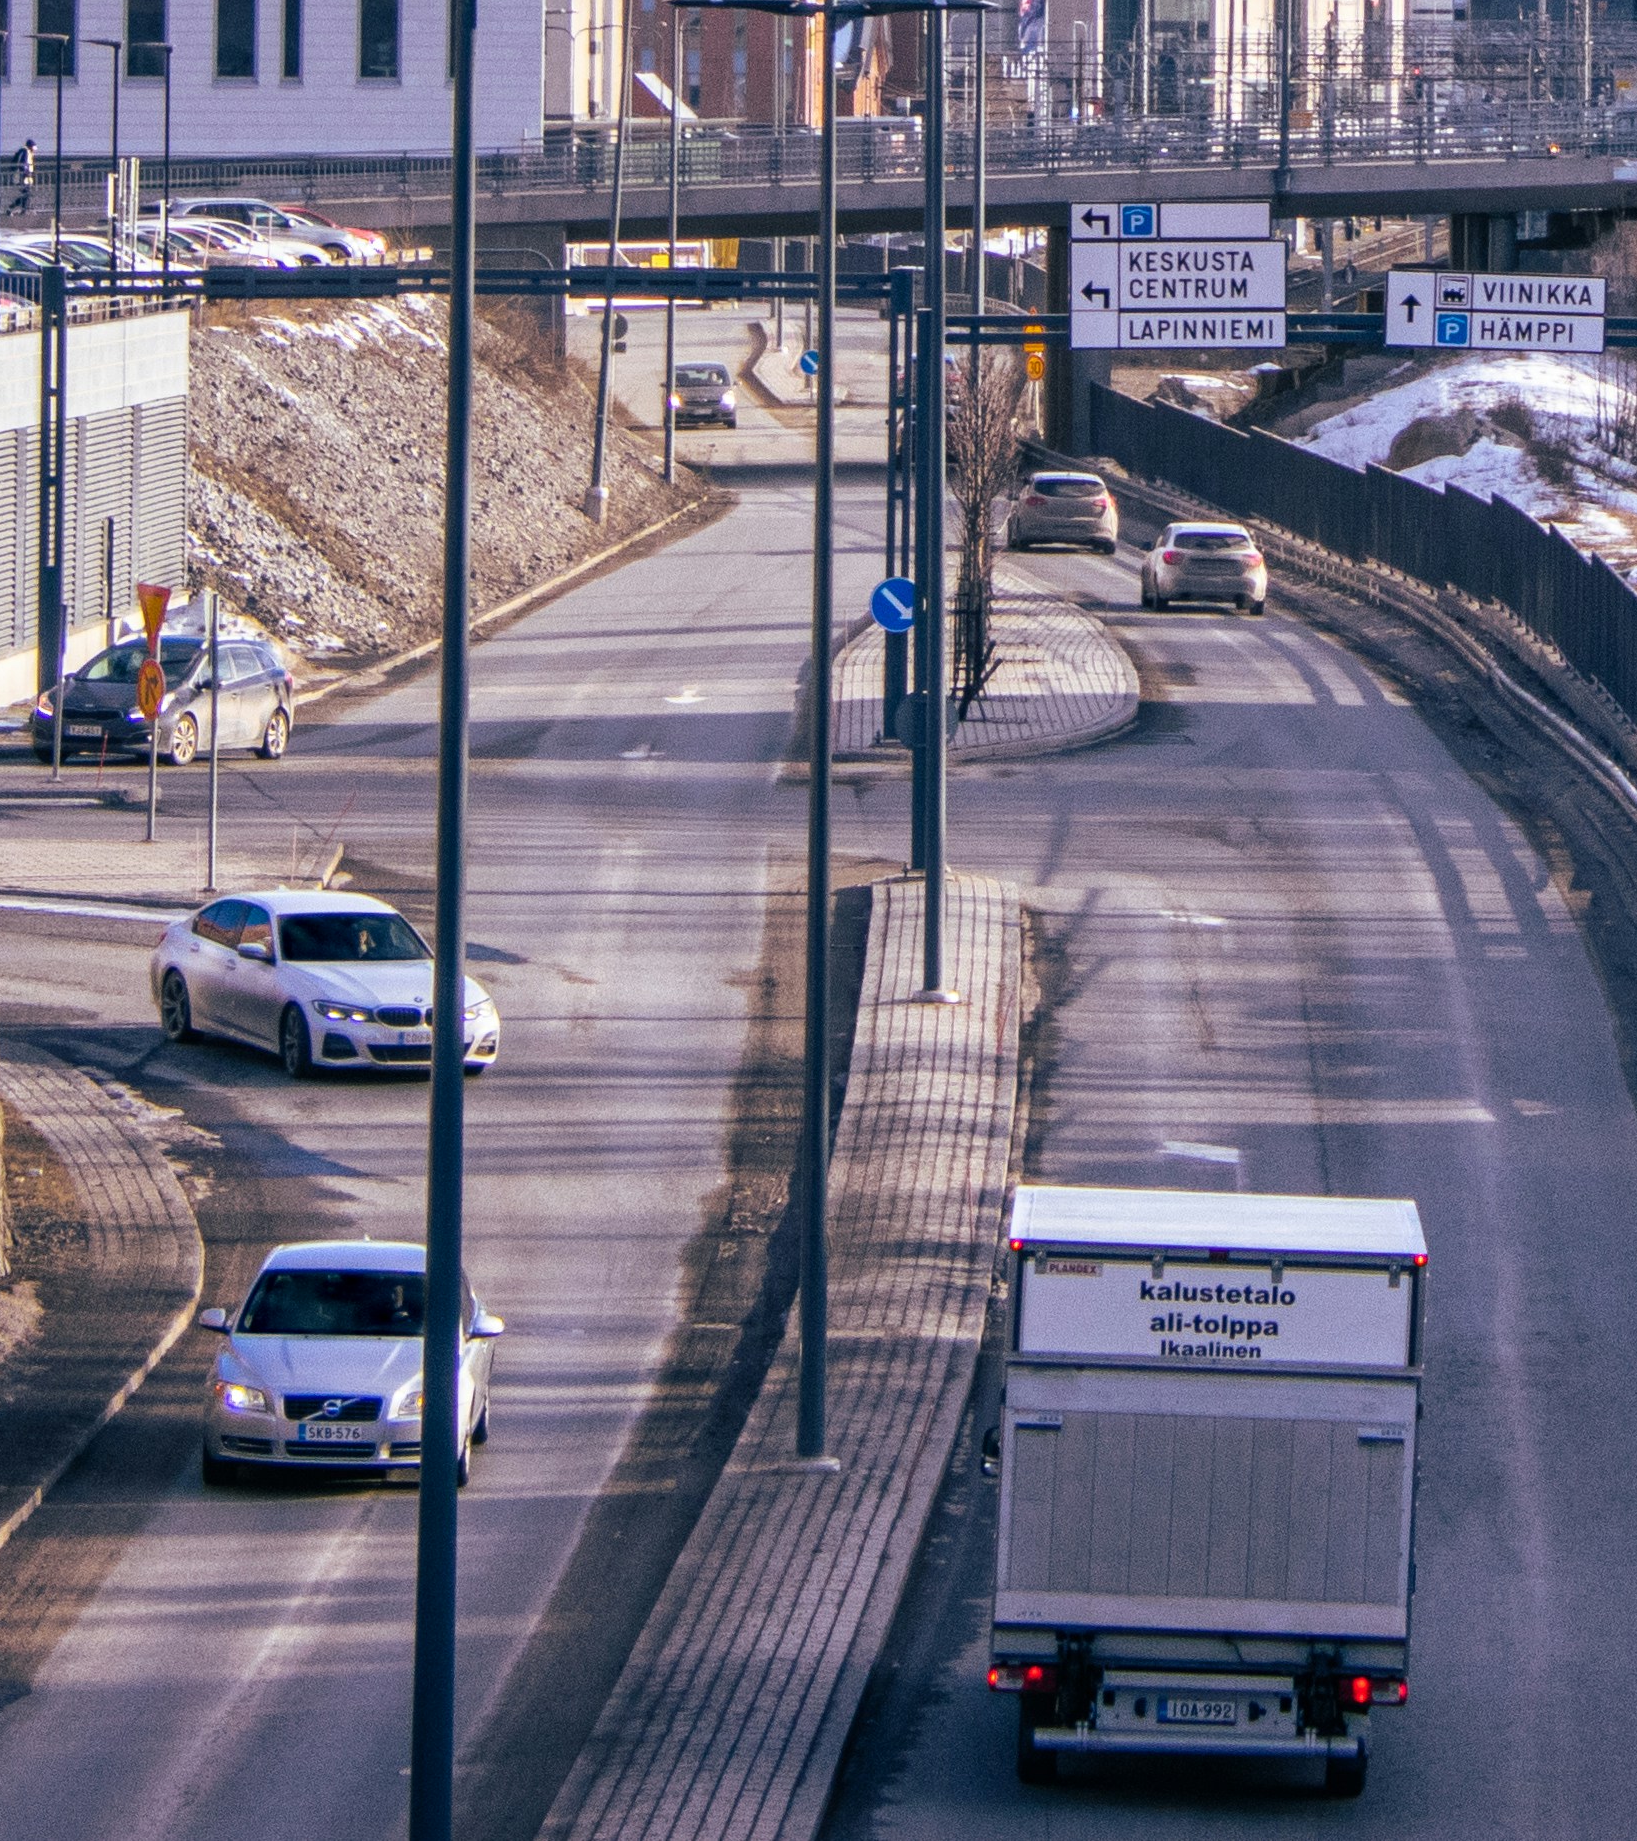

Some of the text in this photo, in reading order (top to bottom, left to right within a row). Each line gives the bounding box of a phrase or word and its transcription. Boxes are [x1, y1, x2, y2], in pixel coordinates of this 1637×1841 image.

[1128, 250, 1255, 272] KESKUSTA
[1128, 278, 1248, 298] CENTRUM
[1483, 282, 1592, 306] VIINIKKA
[1128, 319, 1274, 340] LAPINNIEMI
[1480, 317, 1574, 344] HÄMPPI
[1139, 1280, 1296, 1306] kalustetalo
[1150, 1313, 1280, 1340] ali-tolppa
[1160, 1340, 1261, 1358] Ikaalinen
[308, 1426, 361, 1439] SKB-576
